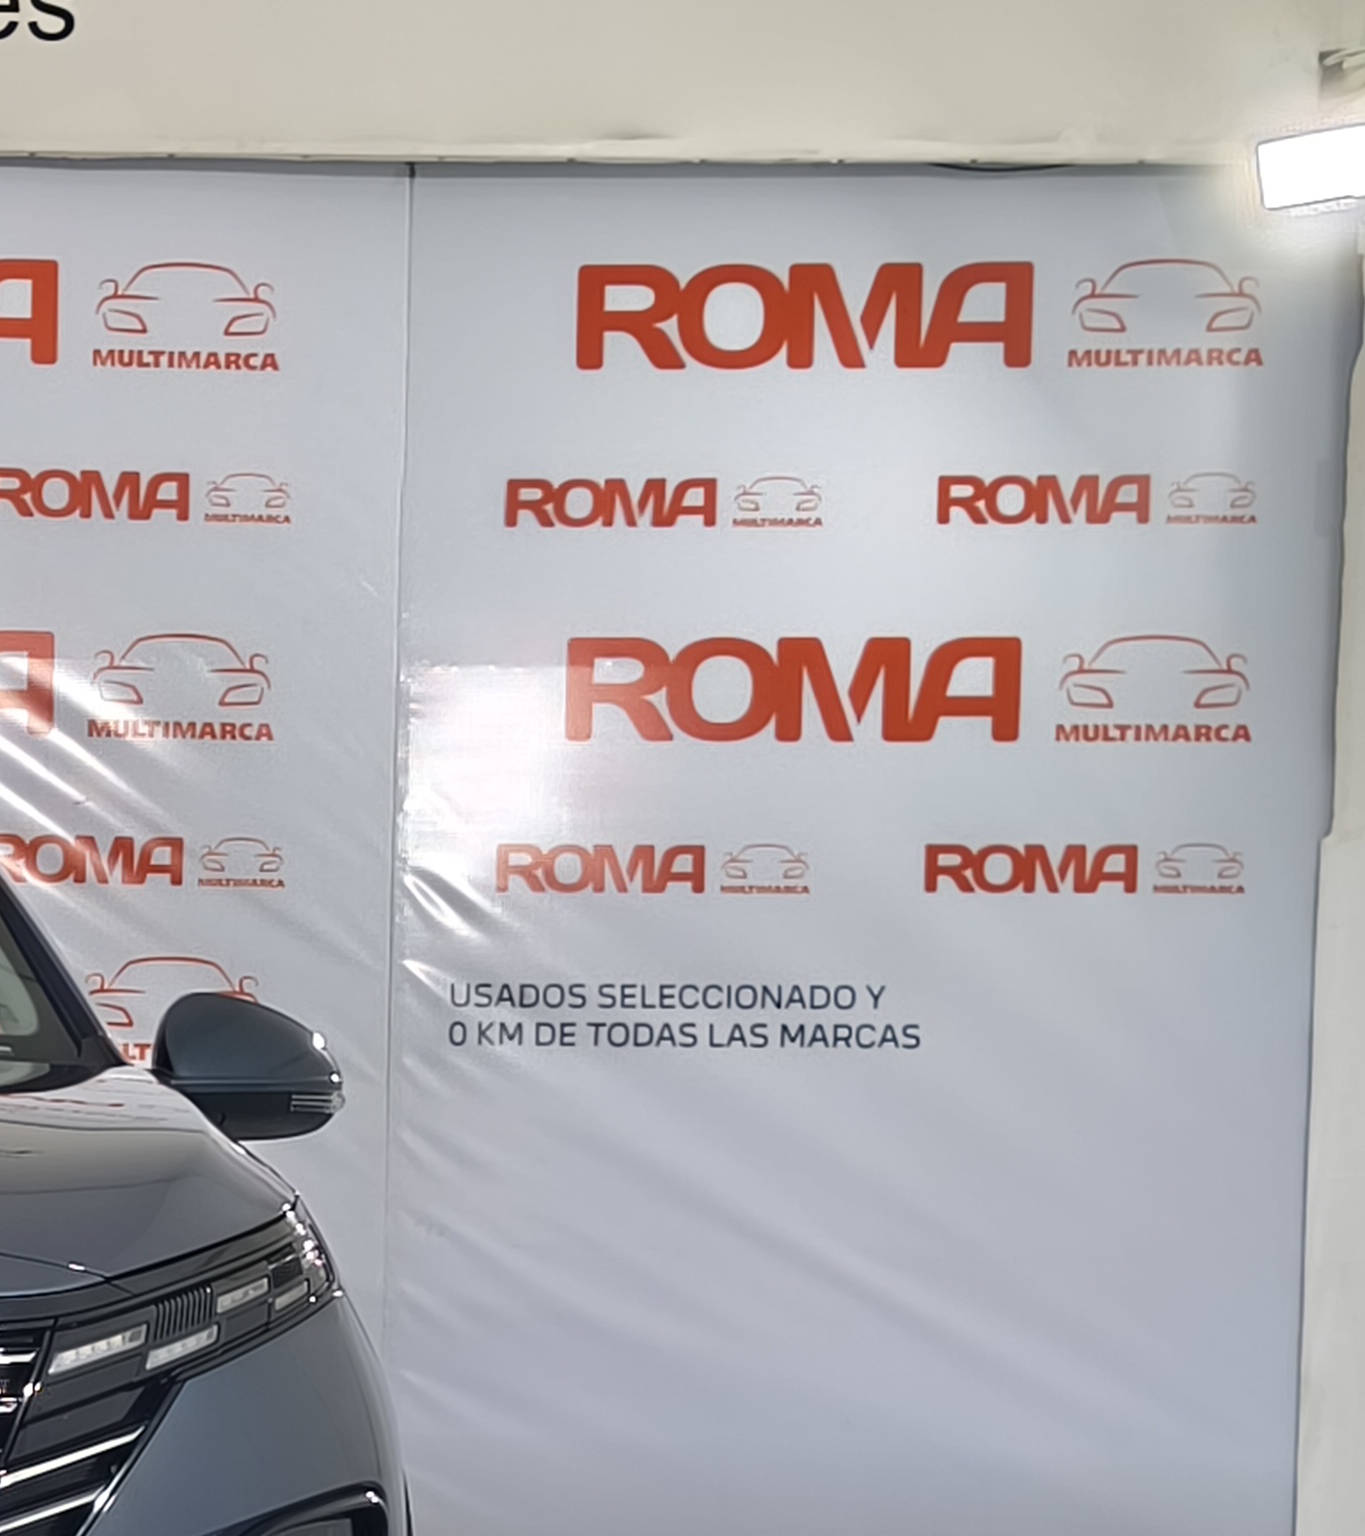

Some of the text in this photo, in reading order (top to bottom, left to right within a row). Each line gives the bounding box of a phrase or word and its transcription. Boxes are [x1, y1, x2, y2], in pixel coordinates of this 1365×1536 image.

[575, 262, 1035, 371] ROMA
[92, 349, 280, 372] MULTIMARCA
[1067, 349, 1263, 368] MULTIMARCA
[505, 478, 719, 528] ROMA
[937, 475, 1152, 525] ROMA
[565, 636, 1023, 743] ROMA
[88, 719, 275, 741] MULTIMARCA
[1055, 724, 1251, 743] MULTIMARCA
[497, 844, 707, 894] ROMA
[924, 844, 1139, 894] ROMA
[450, 982, 886, 1011] USADOS SELECCIONADO Y
[477, 1021, 524, 1046] KM
[535, 1022, 577, 1047] DE
[589, 1022, 698, 1048] TODAS
[709, 1023, 769, 1049] LAS
[780, 1024, 921, 1050] MARCAS
